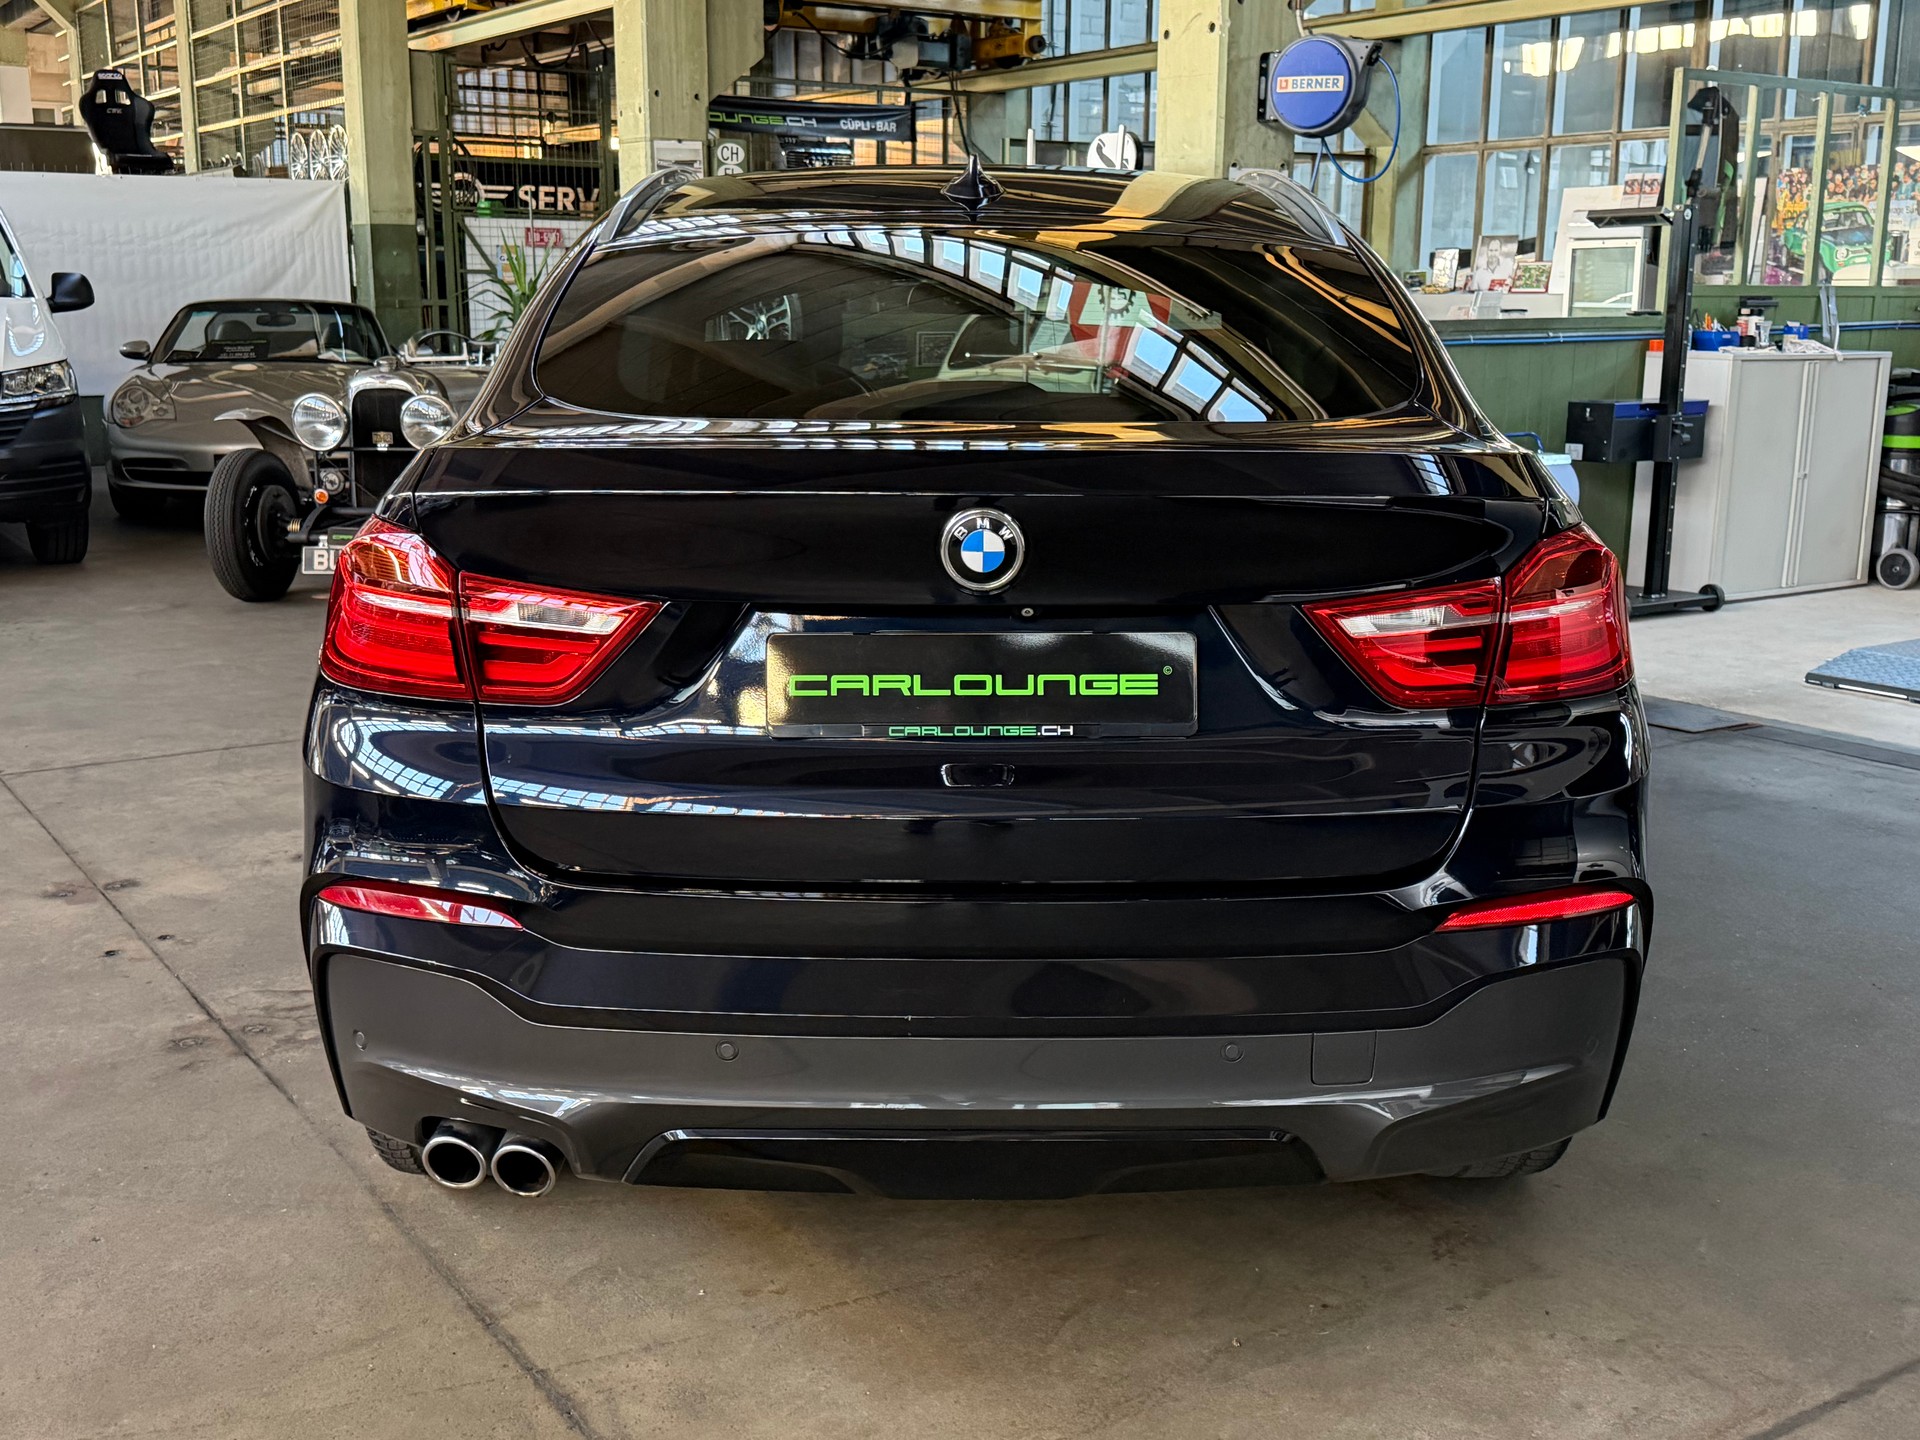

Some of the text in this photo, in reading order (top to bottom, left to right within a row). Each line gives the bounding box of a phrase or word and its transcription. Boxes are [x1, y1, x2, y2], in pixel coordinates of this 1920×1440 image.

[1291, 77, 1340, 90] BERNER
[720, 145, 739, 162] CH
[953, 517, 1014, 541] BMW
[788, 673, 1159, 697] CARLOUNGE
[888, 725, 1074, 737] CARLOUNGE.CH
